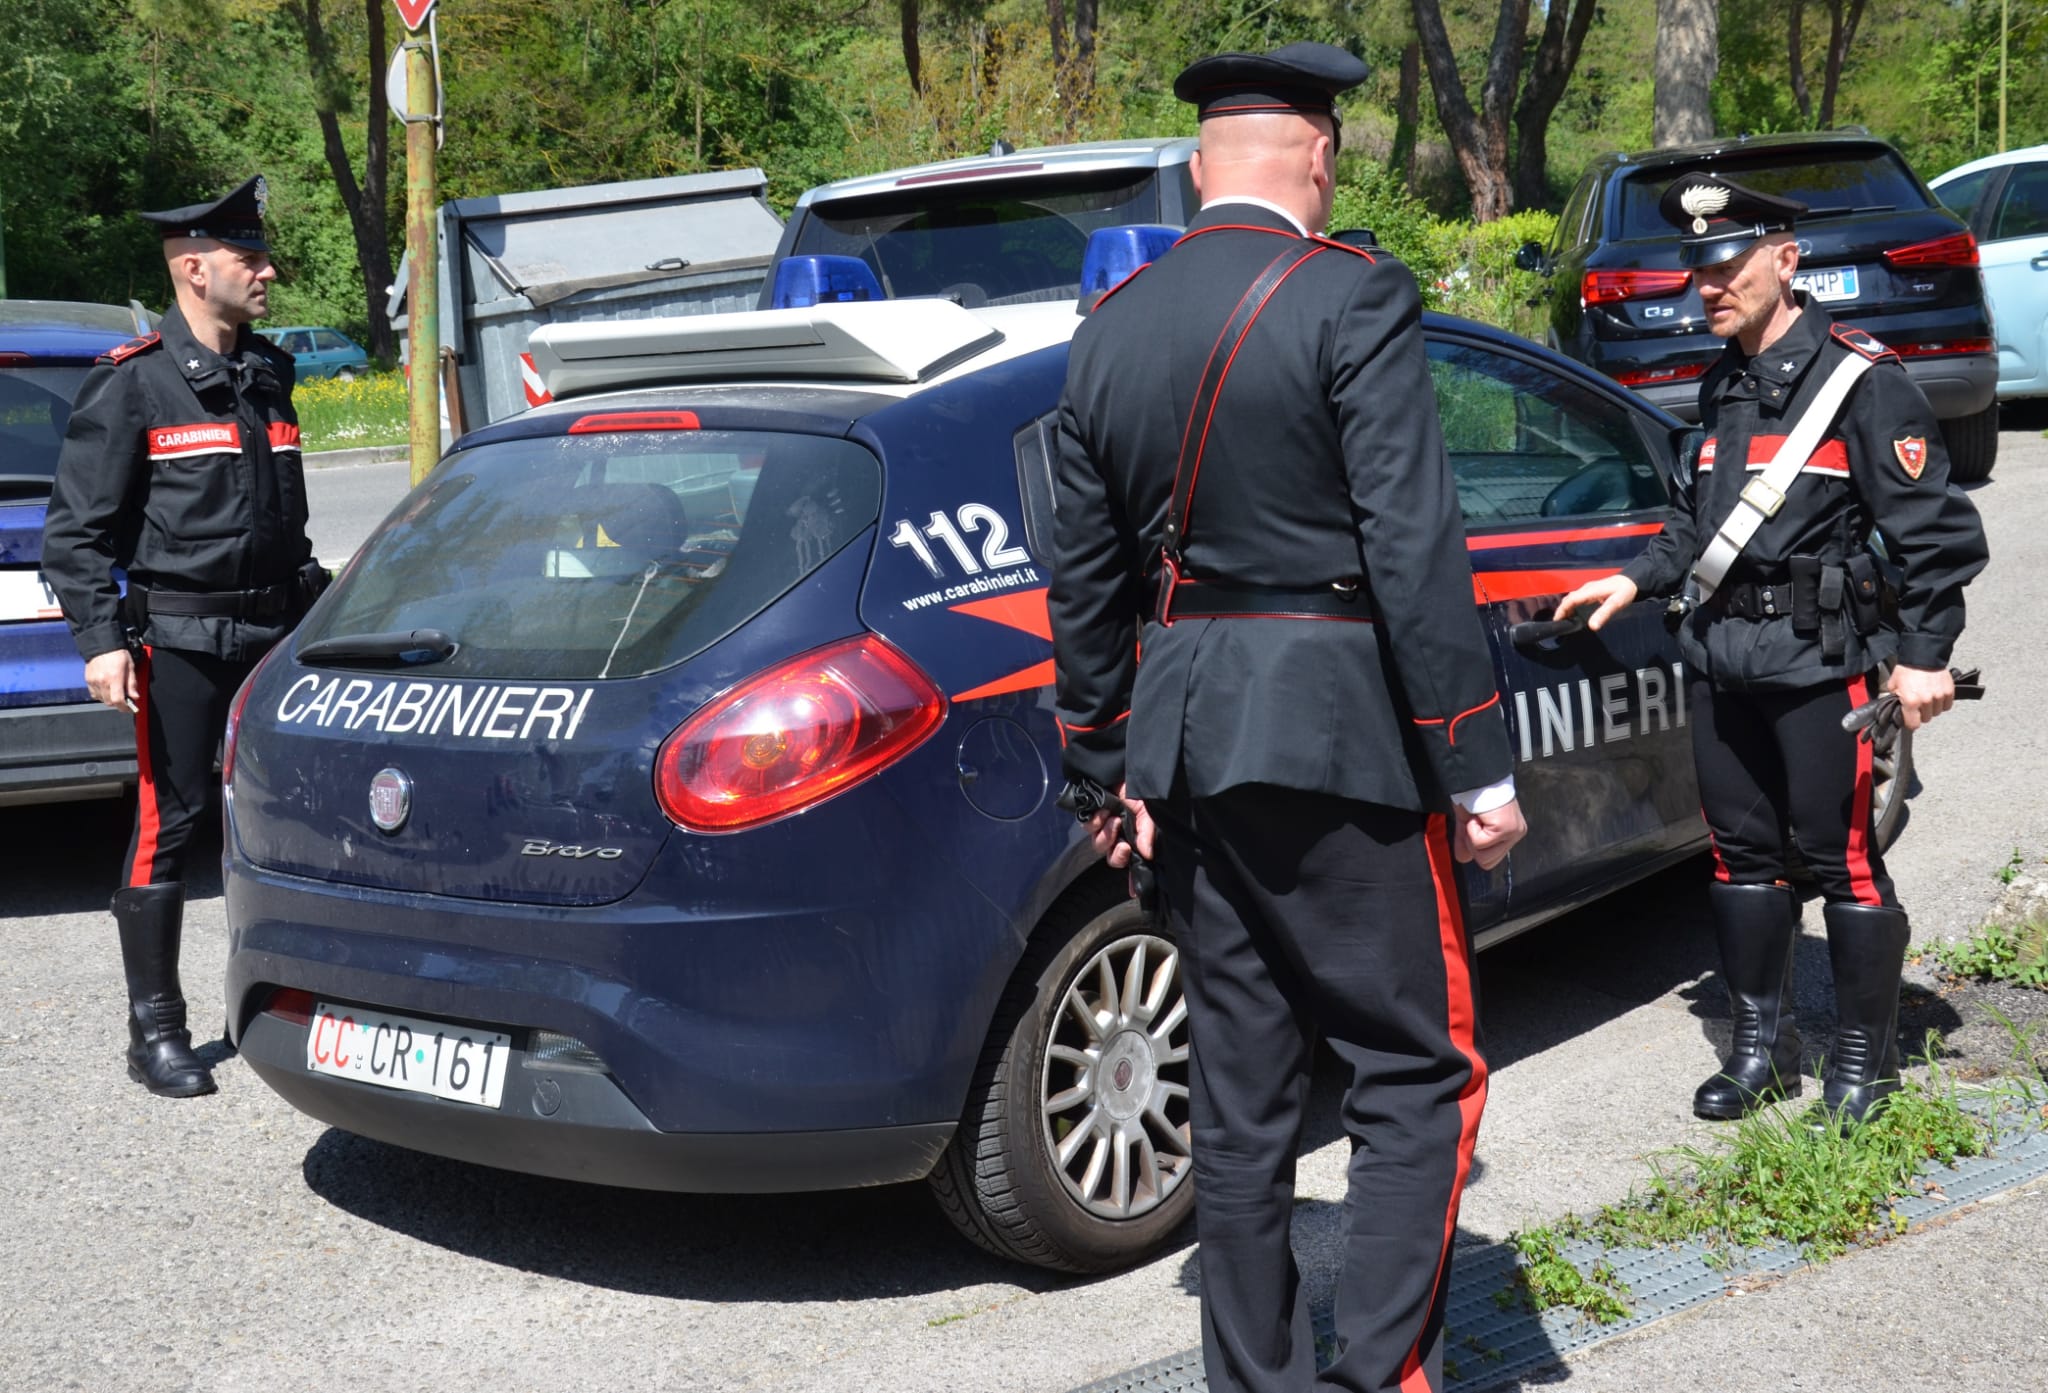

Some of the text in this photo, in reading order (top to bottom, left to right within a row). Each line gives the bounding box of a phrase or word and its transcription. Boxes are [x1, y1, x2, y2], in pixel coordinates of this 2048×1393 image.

[888, 502, 1031, 579] 112
[902, 567, 1040, 612] www.carabinieri.it
[276, 673, 595, 740] CARABINIERI
[1500, 661, 1687, 763] INIERI
[521, 839, 623, 859] Bravo
[314, 1011, 495, 1096] CC CR 161
